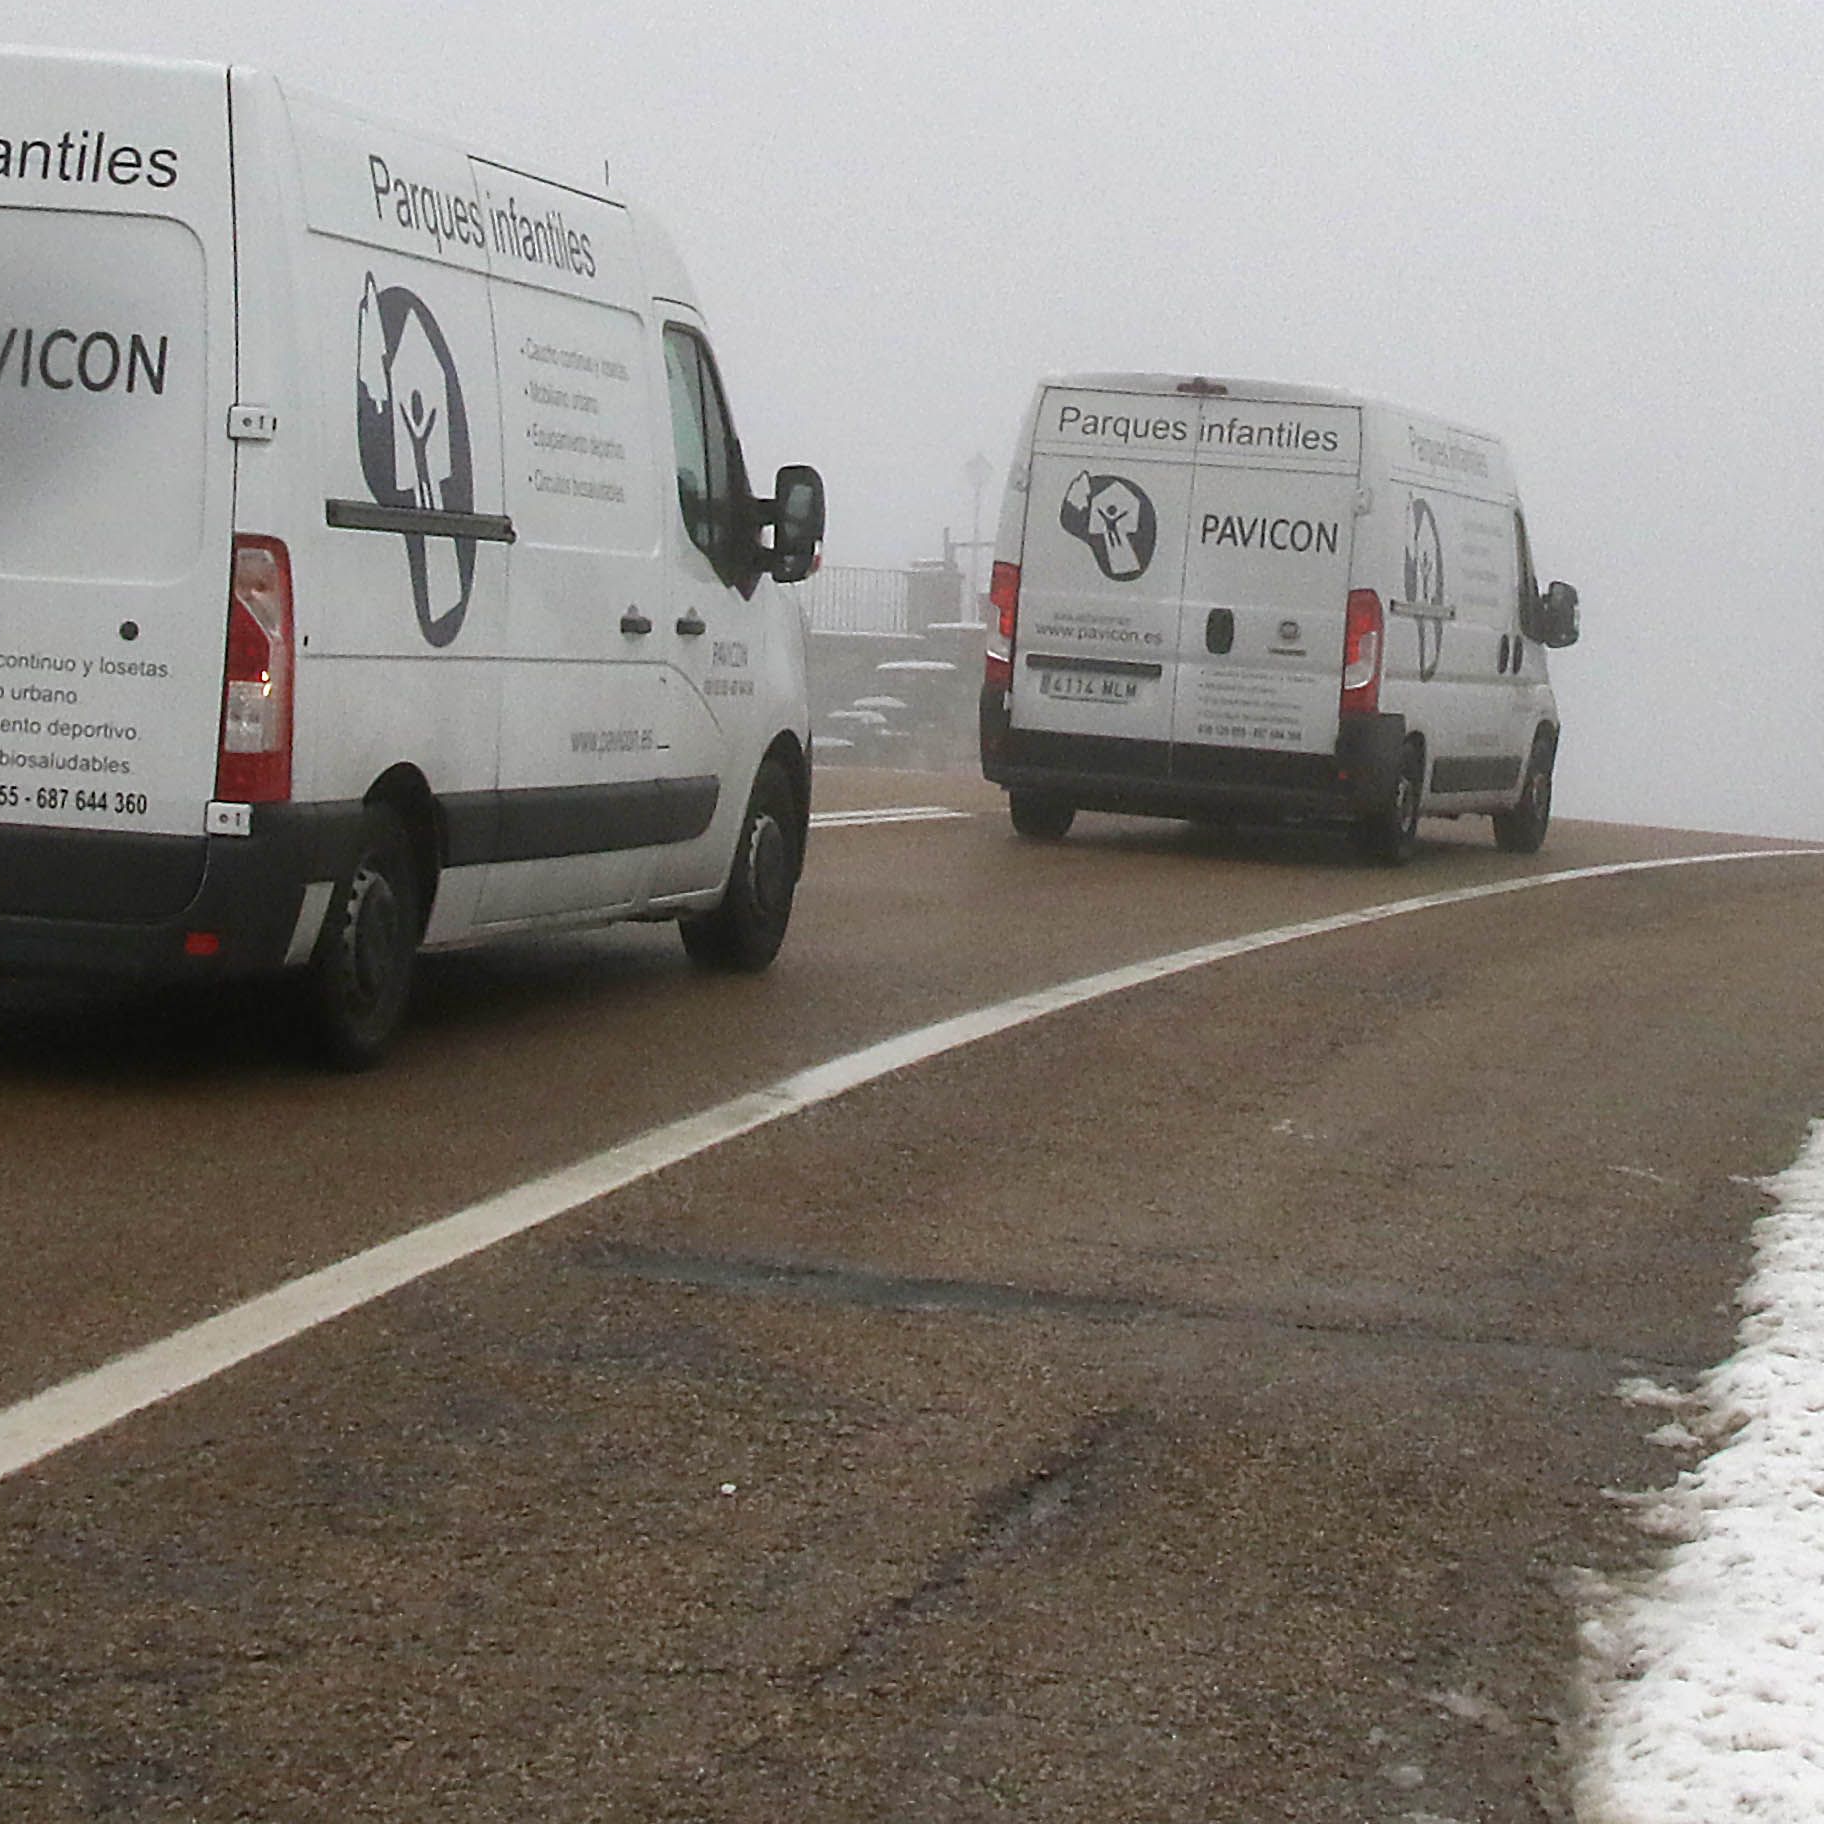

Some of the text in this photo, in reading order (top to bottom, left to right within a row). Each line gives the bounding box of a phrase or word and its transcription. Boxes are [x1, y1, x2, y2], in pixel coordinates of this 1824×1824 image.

[368, 154, 596, 278] Parques infantiles
[1058, 406, 1338, 452] Parques infantiles
[1201, 514, 1339, 554] PAVICON
[83, 659, 93, 676] y
[37, 787, 68, 809] 687
[76, 790, 107, 811] 644
[114, 792, 147, 815] 360
